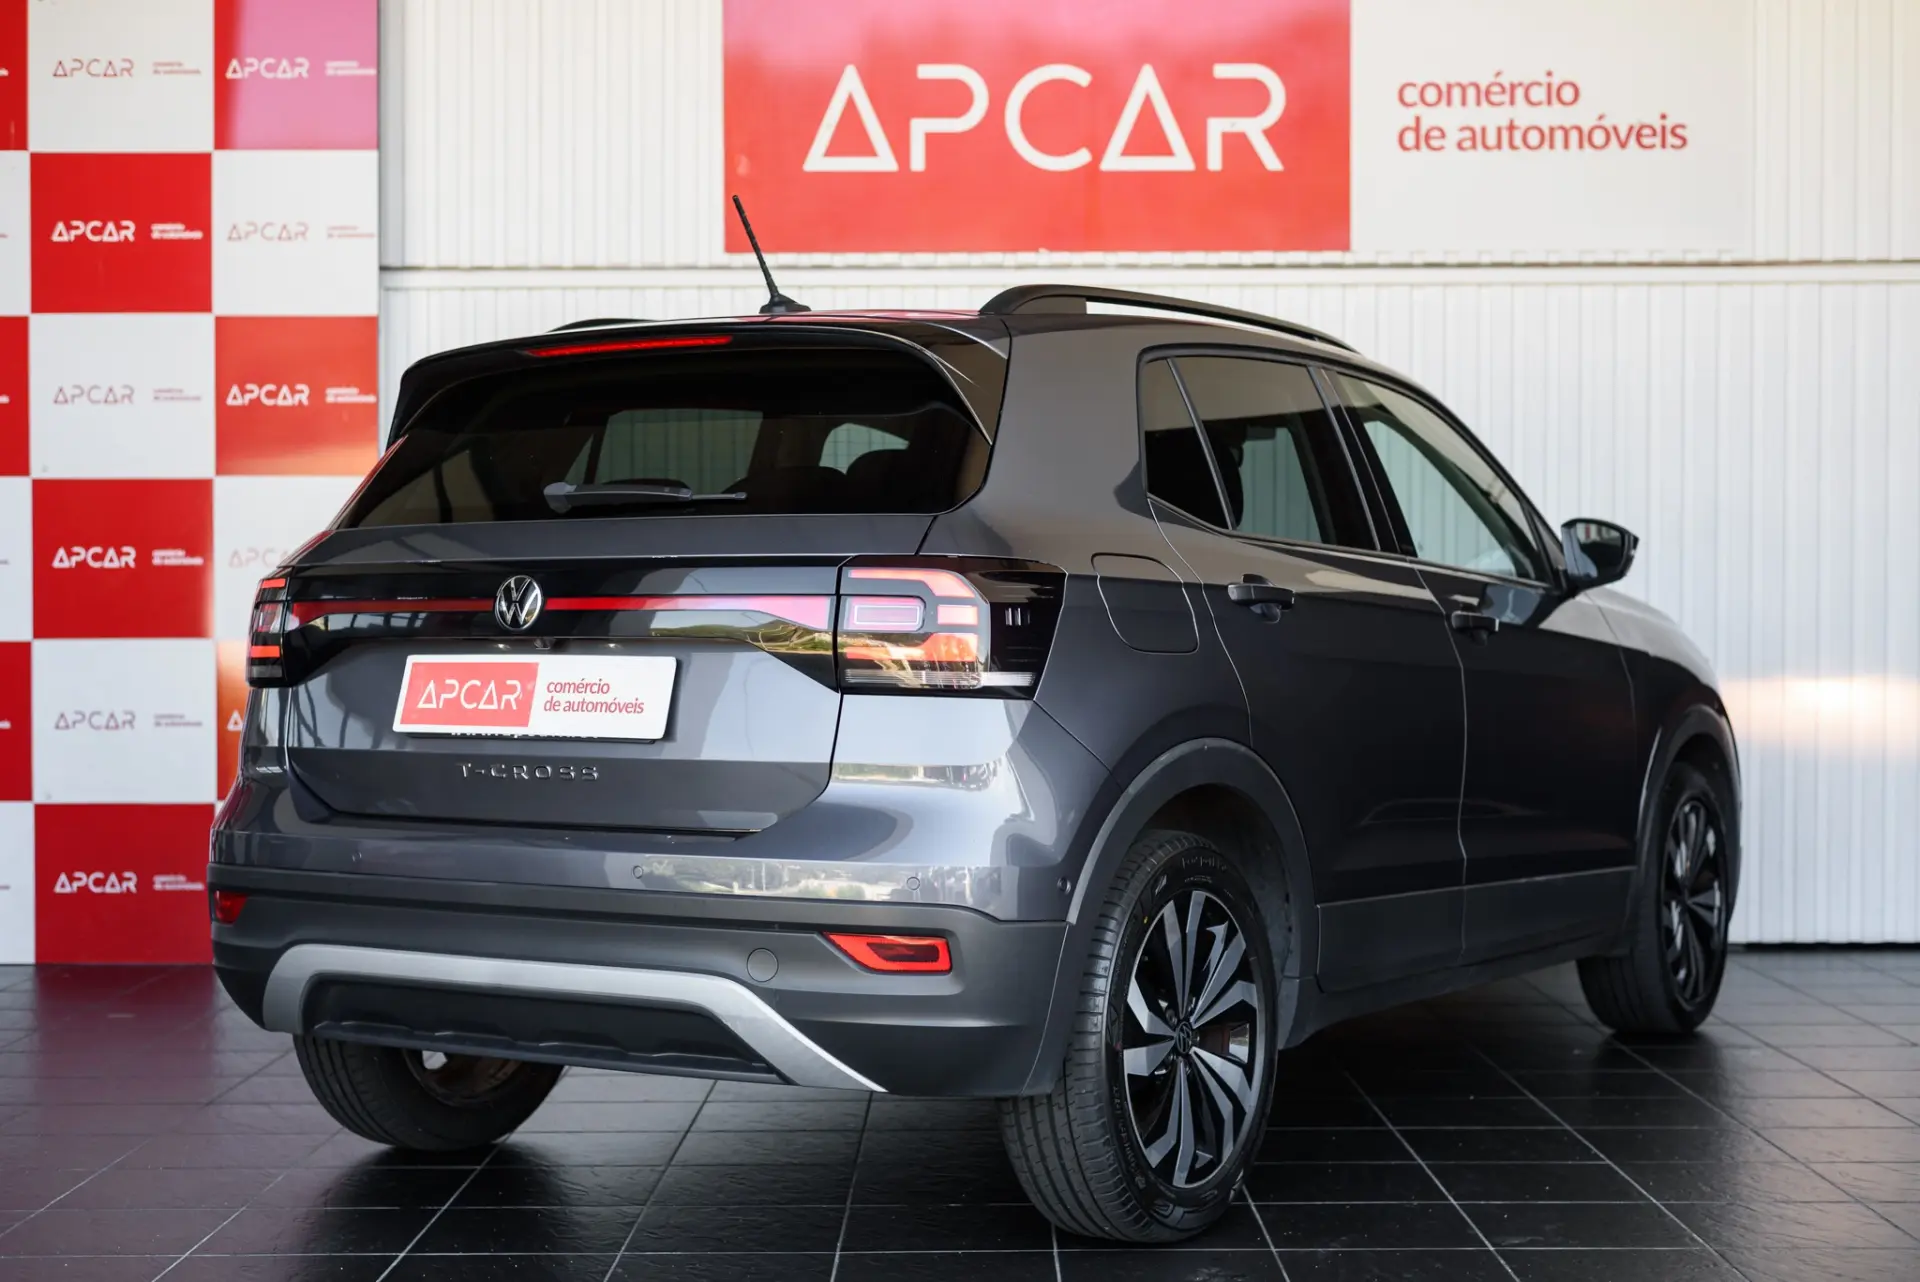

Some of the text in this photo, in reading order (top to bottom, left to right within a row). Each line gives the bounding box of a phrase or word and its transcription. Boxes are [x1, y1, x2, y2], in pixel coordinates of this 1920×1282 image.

[53, 58, 134, 77] APCAR
[225, 57, 310, 79] APCAR
[1398, 71, 1580, 109] comércio
[803, 63, 1287, 172] APCAR
[1398, 112, 1688, 152] de automóveis
[51, 220, 136, 242] APCAR
[227, 222, 309, 242] APCAR
[53, 385, 135, 405] APCAR
[226, 383, 310, 406] APCAR
[52, 546, 137, 568] APCAR
[417, 679, 523, 710] APCAR
[546, 678, 610, 695] comércio
[543, 696, 645, 714] de automóveis
[55, 711, 136, 730] APCAR
[456, 762, 600, 781] T-CROSS
[54, 872, 137, 893] APCAR
